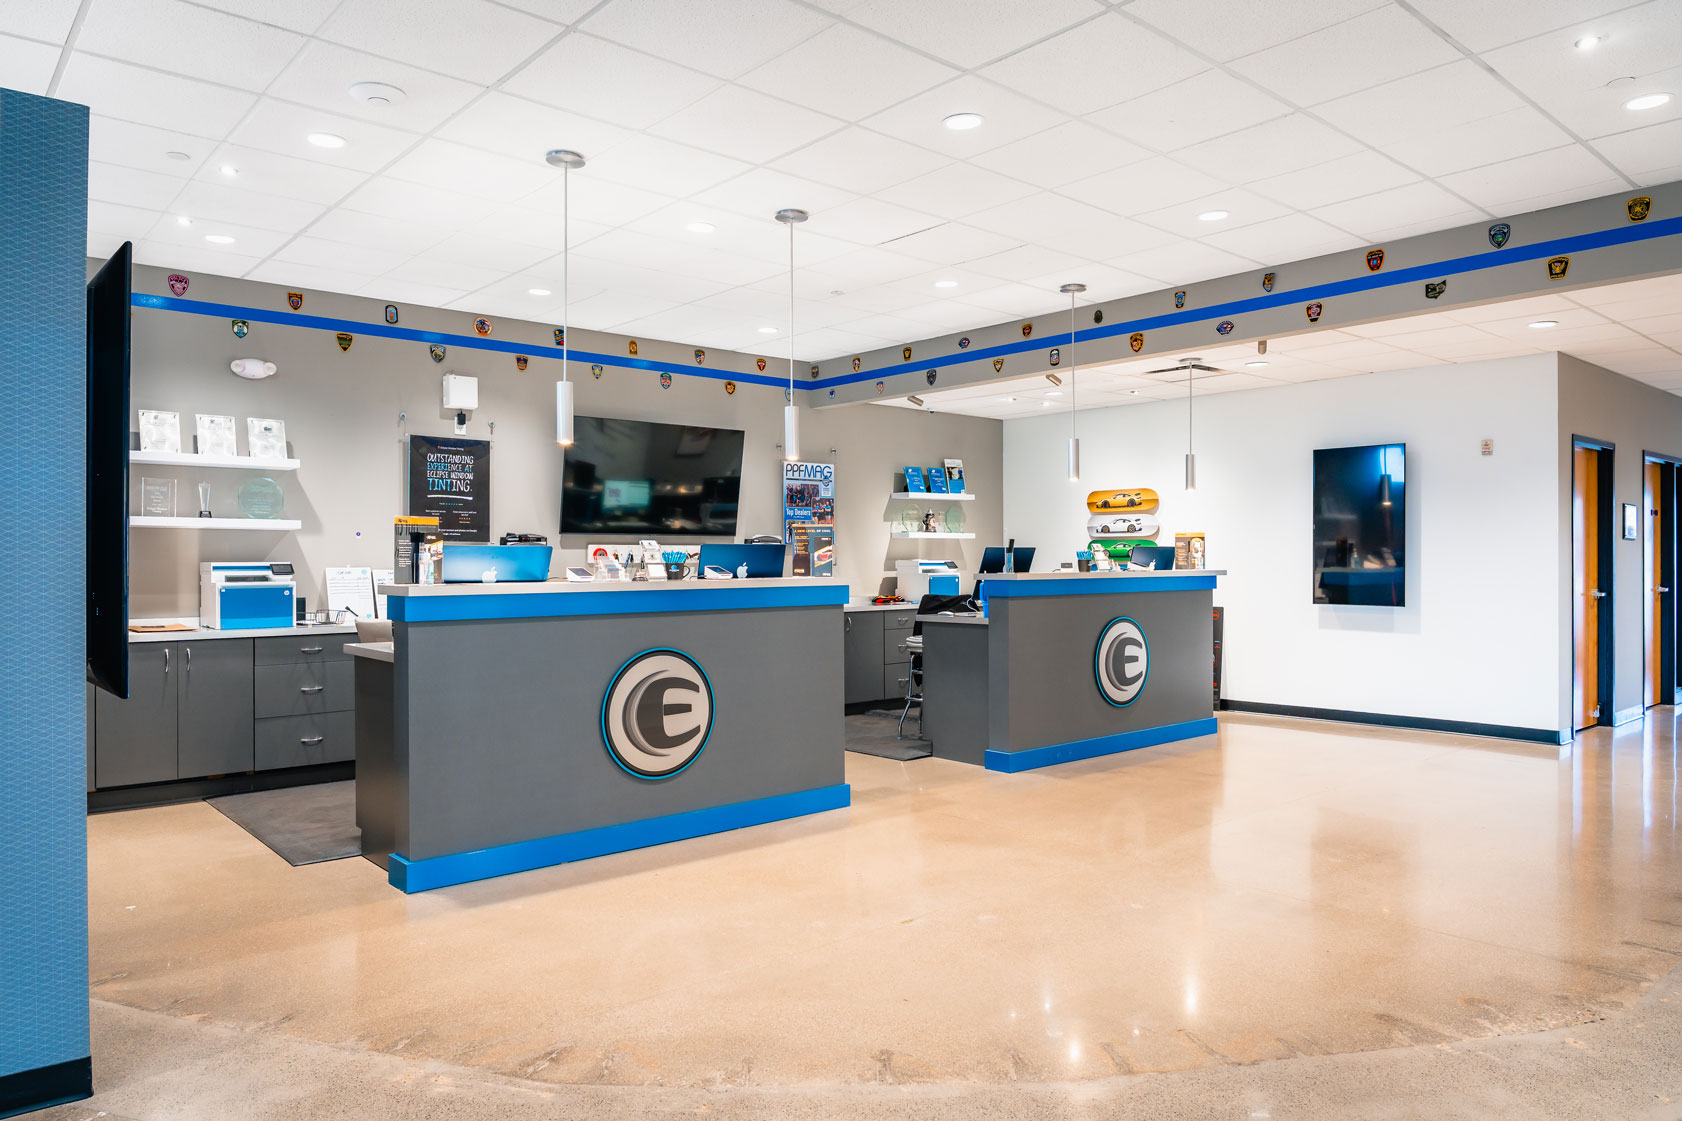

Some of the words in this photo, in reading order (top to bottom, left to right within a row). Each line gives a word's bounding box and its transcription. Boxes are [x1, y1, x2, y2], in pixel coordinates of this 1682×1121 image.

[427, 452, 474, 464] OUTSTANDING
[427, 462, 462, 472] EXPERIENCE
[464, 464, 474, 472] AT
[785, 463, 833, 479] PPFMAG
[427, 470, 449, 479] ECLIPSE
[450, 472, 474, 480] WINDOW
[427, 478, 473, 493] TINTING.
[786, 508, 794, 517] Top
[795, 508, 811, 516] Dealers
[1112, 637, 1143, 687] E
[637, 676, 701, 750] E
